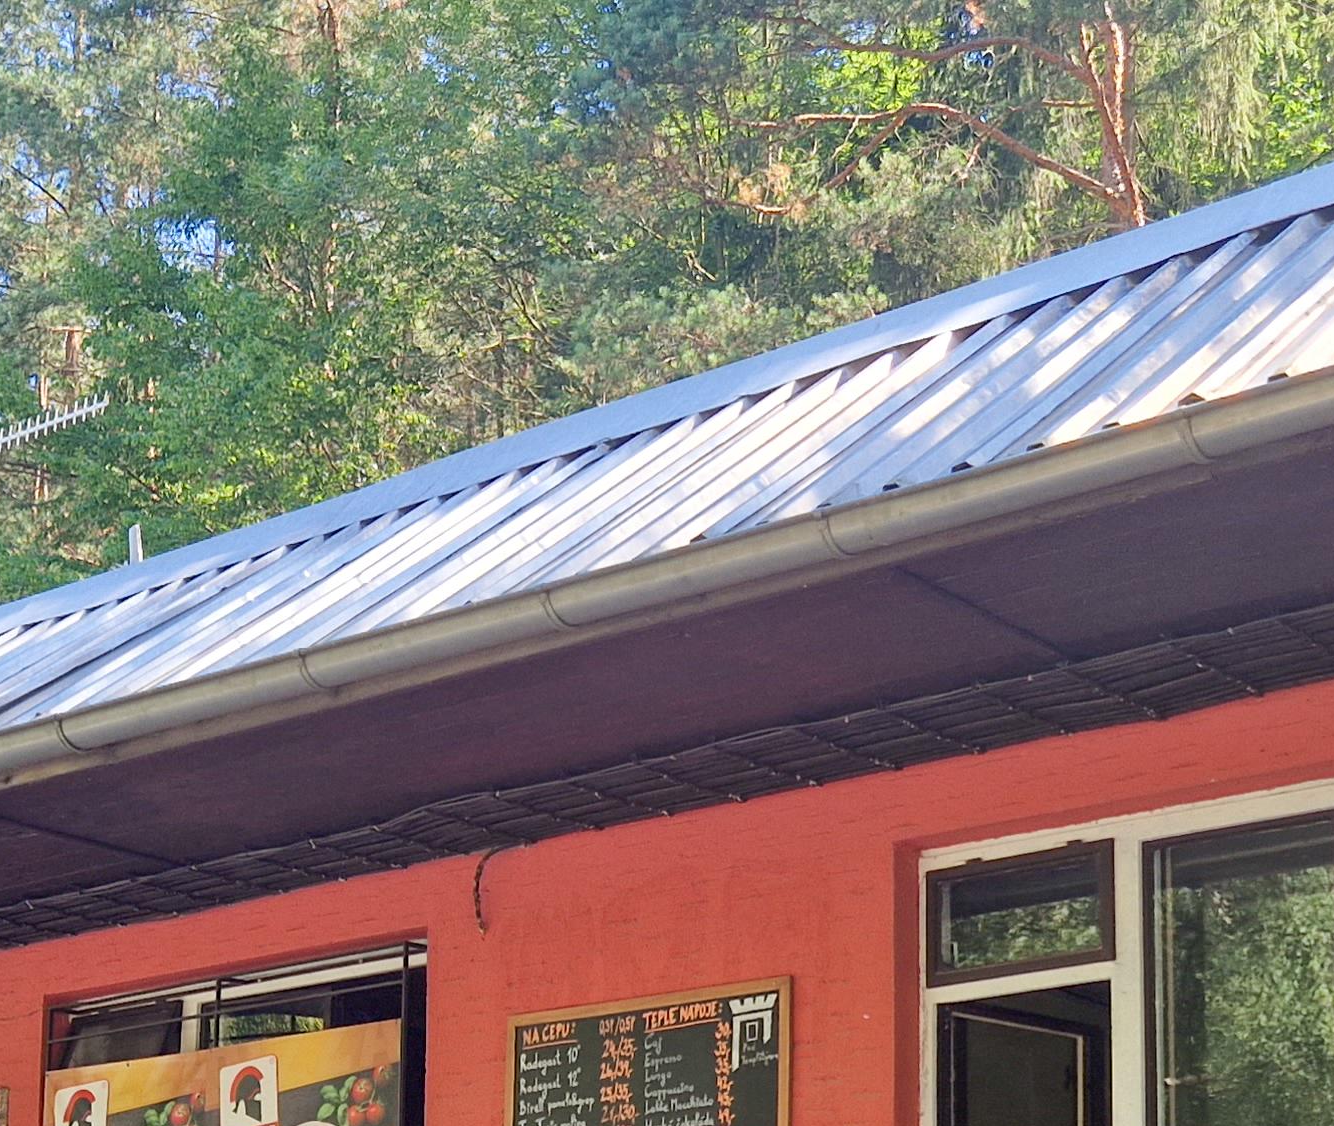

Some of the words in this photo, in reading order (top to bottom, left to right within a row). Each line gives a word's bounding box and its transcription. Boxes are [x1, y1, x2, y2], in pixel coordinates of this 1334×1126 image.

[522, 1026, 540, 1047] NA
[519, 1049, 563, 1076] Radegast
[519, 1073, 562, 1097] Radegast
[644, 1069, 672, 1088] Lungo
[644, 1083, 695, 1101] Cappuccino
[644, 1099, 669, 1116] Latte
[670, 1093, 715, 1113] Macchiato
